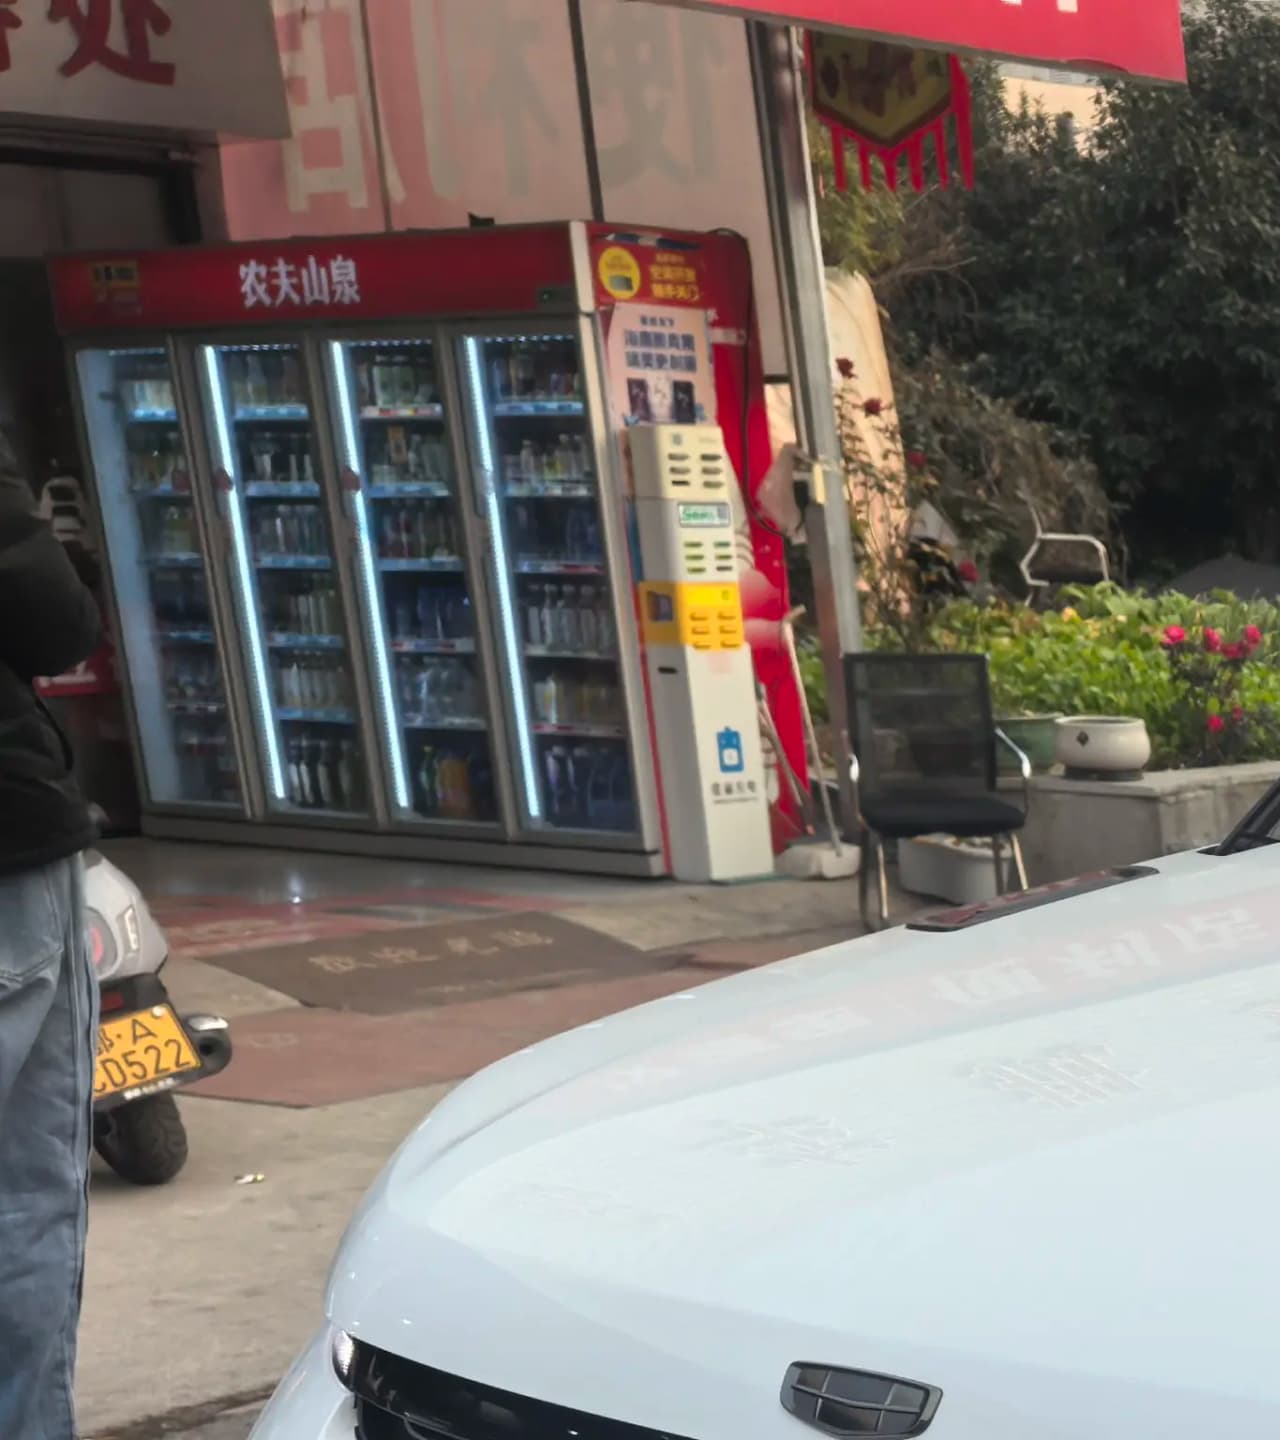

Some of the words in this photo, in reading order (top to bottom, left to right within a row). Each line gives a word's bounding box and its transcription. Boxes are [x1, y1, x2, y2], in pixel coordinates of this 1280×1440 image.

[0, 0, 176, 87] 处
[238, 254, 361, 309] 农夫山泉
